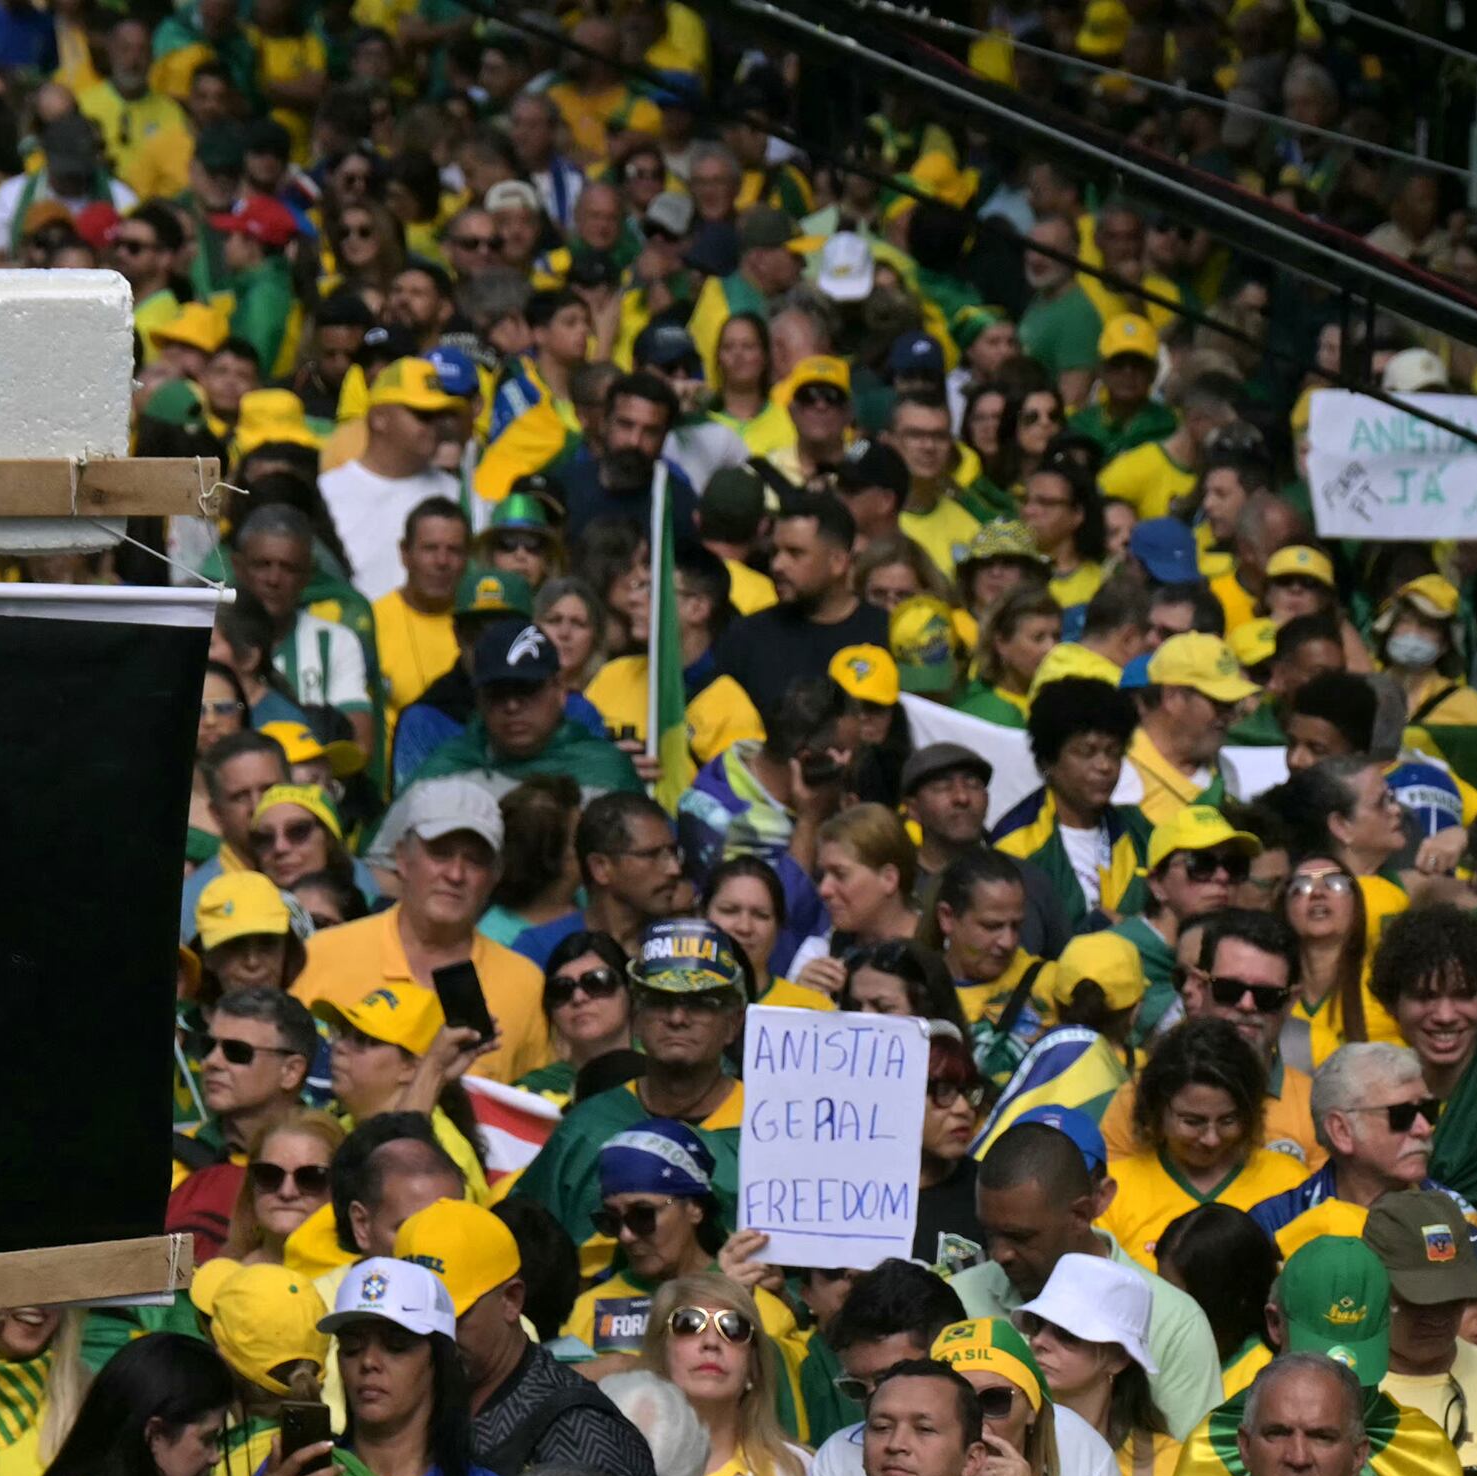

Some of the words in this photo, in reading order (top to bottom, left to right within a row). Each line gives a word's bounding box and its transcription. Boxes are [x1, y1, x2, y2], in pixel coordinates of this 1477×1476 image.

[754, 1022, 906, 1084] ANISTIA
[750, 1096, 898, 1147] GERAL
[745, 1178, 910, 1230] FREEDOM
